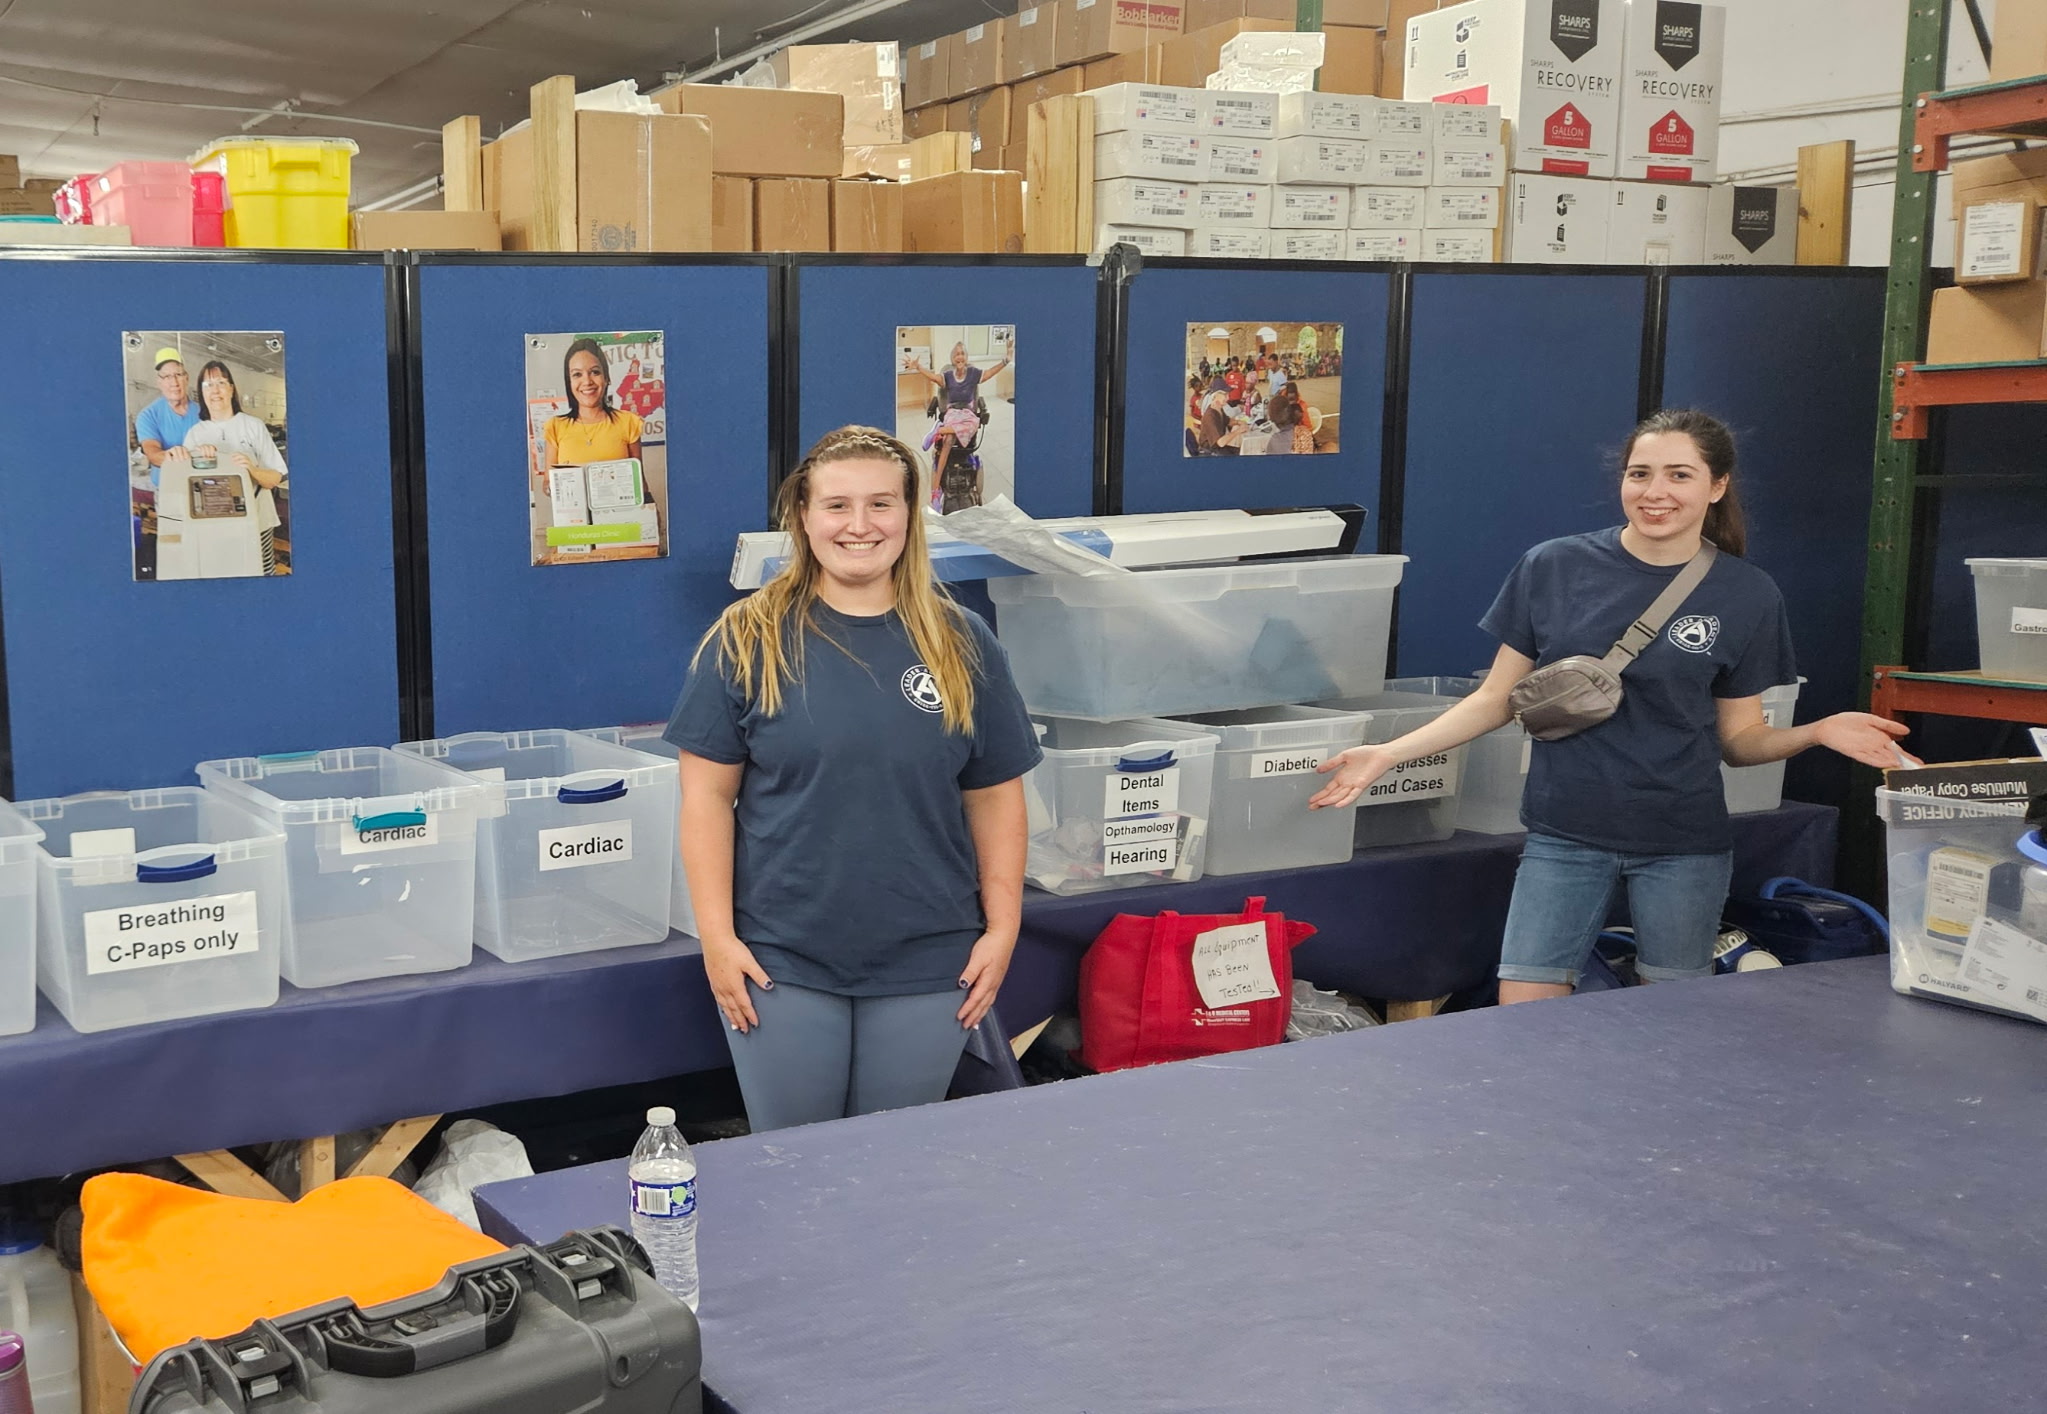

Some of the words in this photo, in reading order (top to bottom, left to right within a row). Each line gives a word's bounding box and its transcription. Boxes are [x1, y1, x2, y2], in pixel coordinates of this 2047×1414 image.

[1559, 14, 1591, 29] SHARPS
[1662, 24, 1694, 38] SHARPS
[1537, 70, 1613, 92] RECOVERY
[1642, 80, 1714, 99] RECOVERY
[1563, 110, 1573, 125] 5
[1667, 118, 1677, 133] 5
[1551, 125, 1585, 137] GALLON
[1655, 132, 1688, 143] GALLON
[1740, 209, 1769, 221] SHARPS
[903, 668, 921, 692] LEADER
[1264, 756, 1318, 773] Diabetic
[1121, 773, 1164, 791] Dental
[1370, 780, 1397, 796] and
[1402, 777, 1444, 793] Cases
[1937, 782, 1968, 797] Copy
[1971, 780, 2028, 797] MultiUse
[1122, 799, 1160, 813] Items
[1902, 806, 1955, 821] OFFICE
[359, 826, 426, 844] Cardiac
[1105, 822, 1175, 838] Opthamology
[549, 836, 624, 859] Cardiac
[1110, 847, 1168, 865] Hearing
[118, 904, 225, 931] Breathing
[107, 940, 186, 963] C-Paps
[194, 930, 239, 950] only
[1930, 978, 1970, 993] HALYARD
